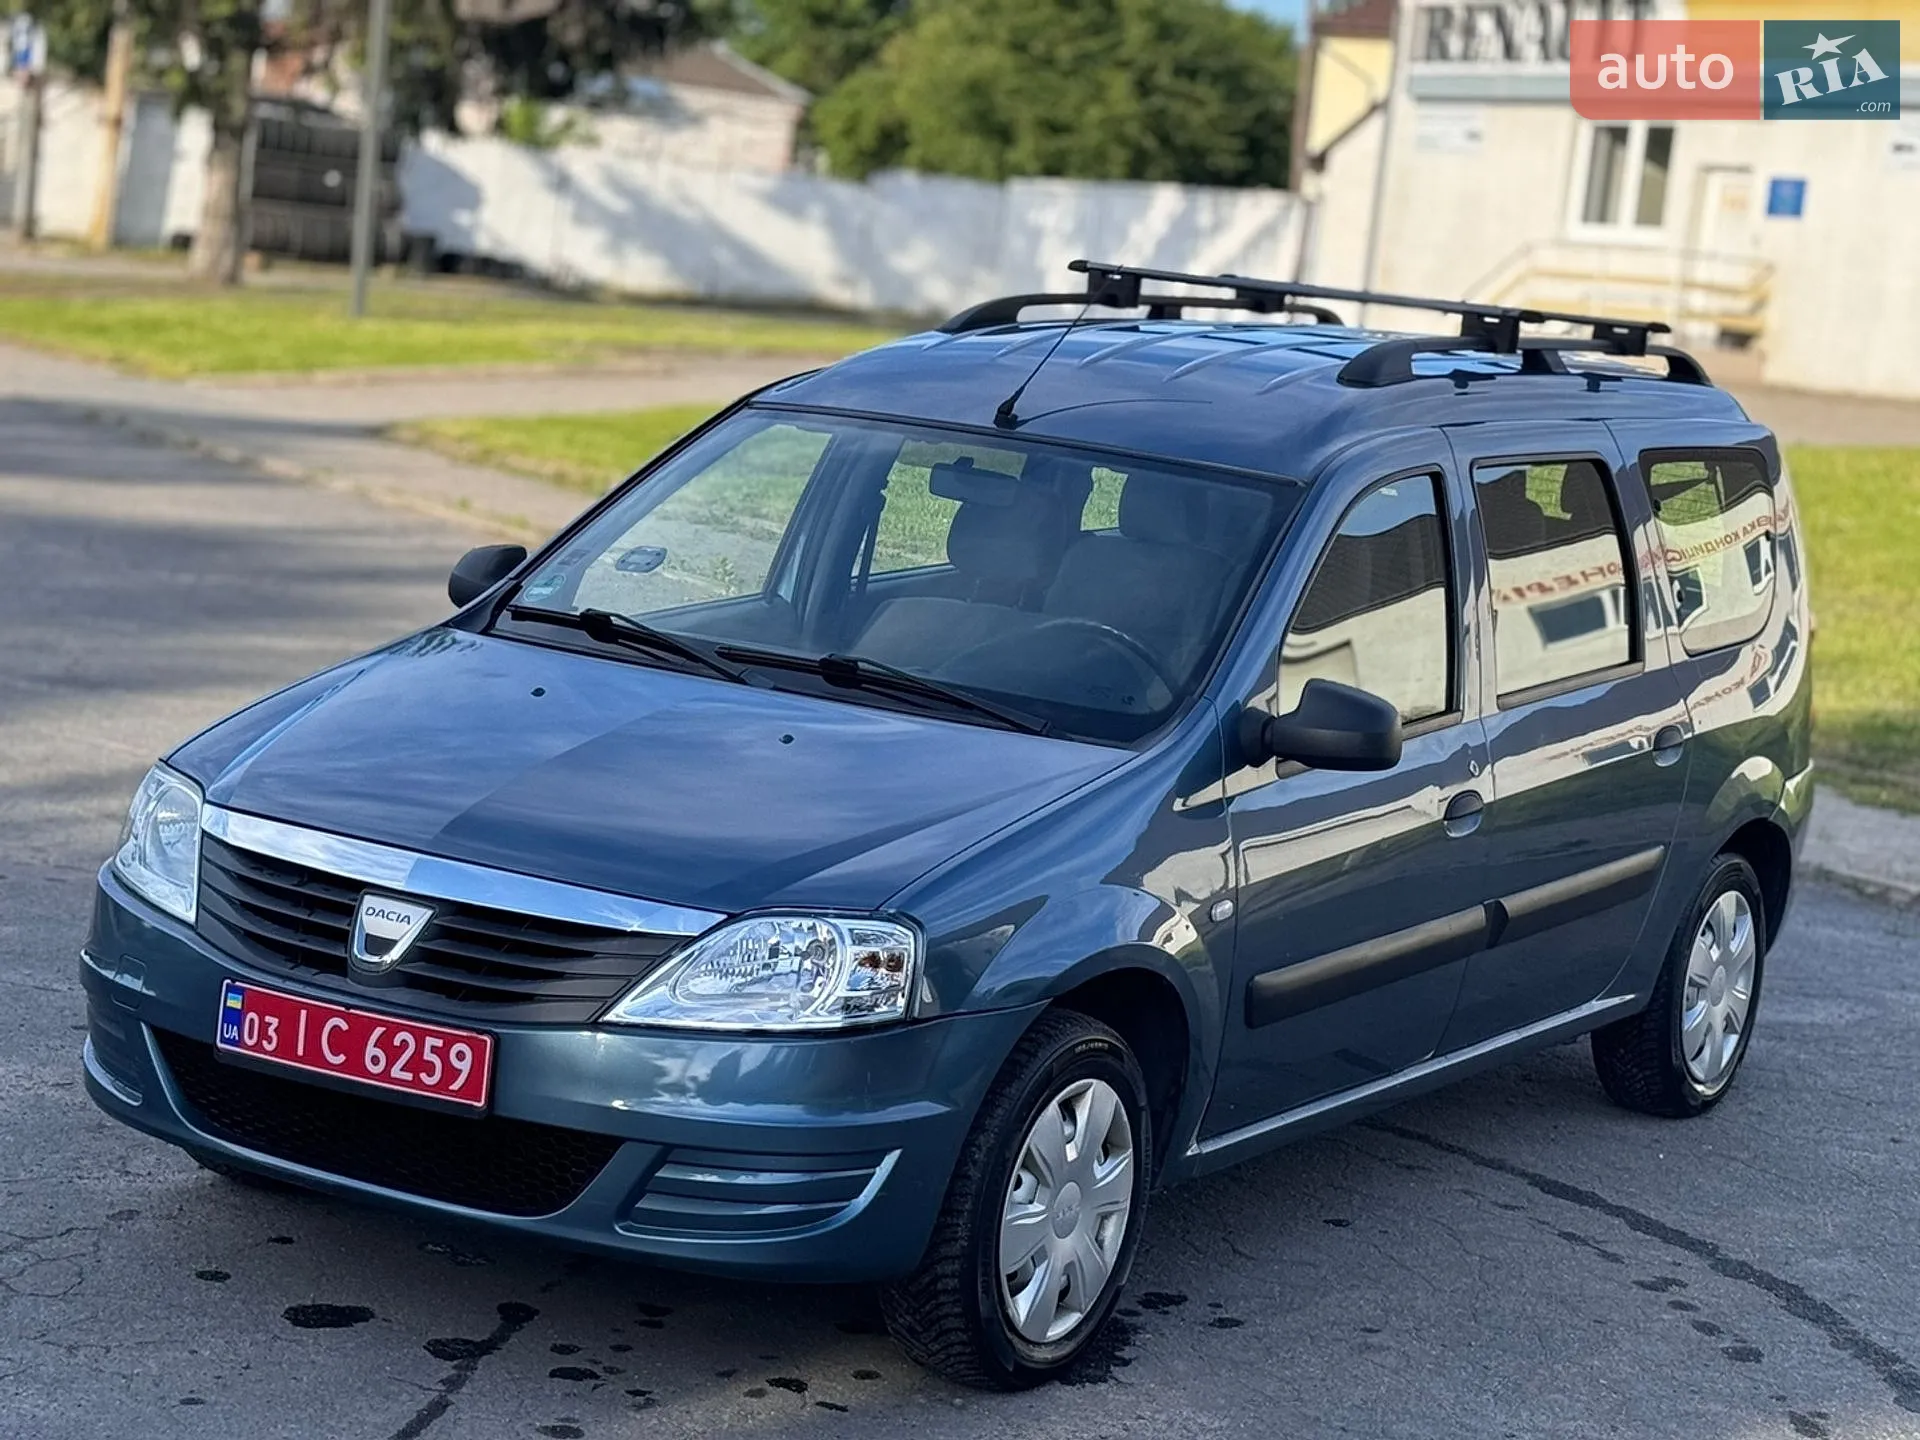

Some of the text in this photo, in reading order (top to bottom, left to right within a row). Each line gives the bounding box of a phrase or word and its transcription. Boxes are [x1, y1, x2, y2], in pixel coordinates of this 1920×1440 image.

[365, 906, 411, 925] DACIA
[223, 1022, 239, 1040] UA
[243, 1011, 279, 1052] 03
[364, 1026, 473, 1091] 6259
